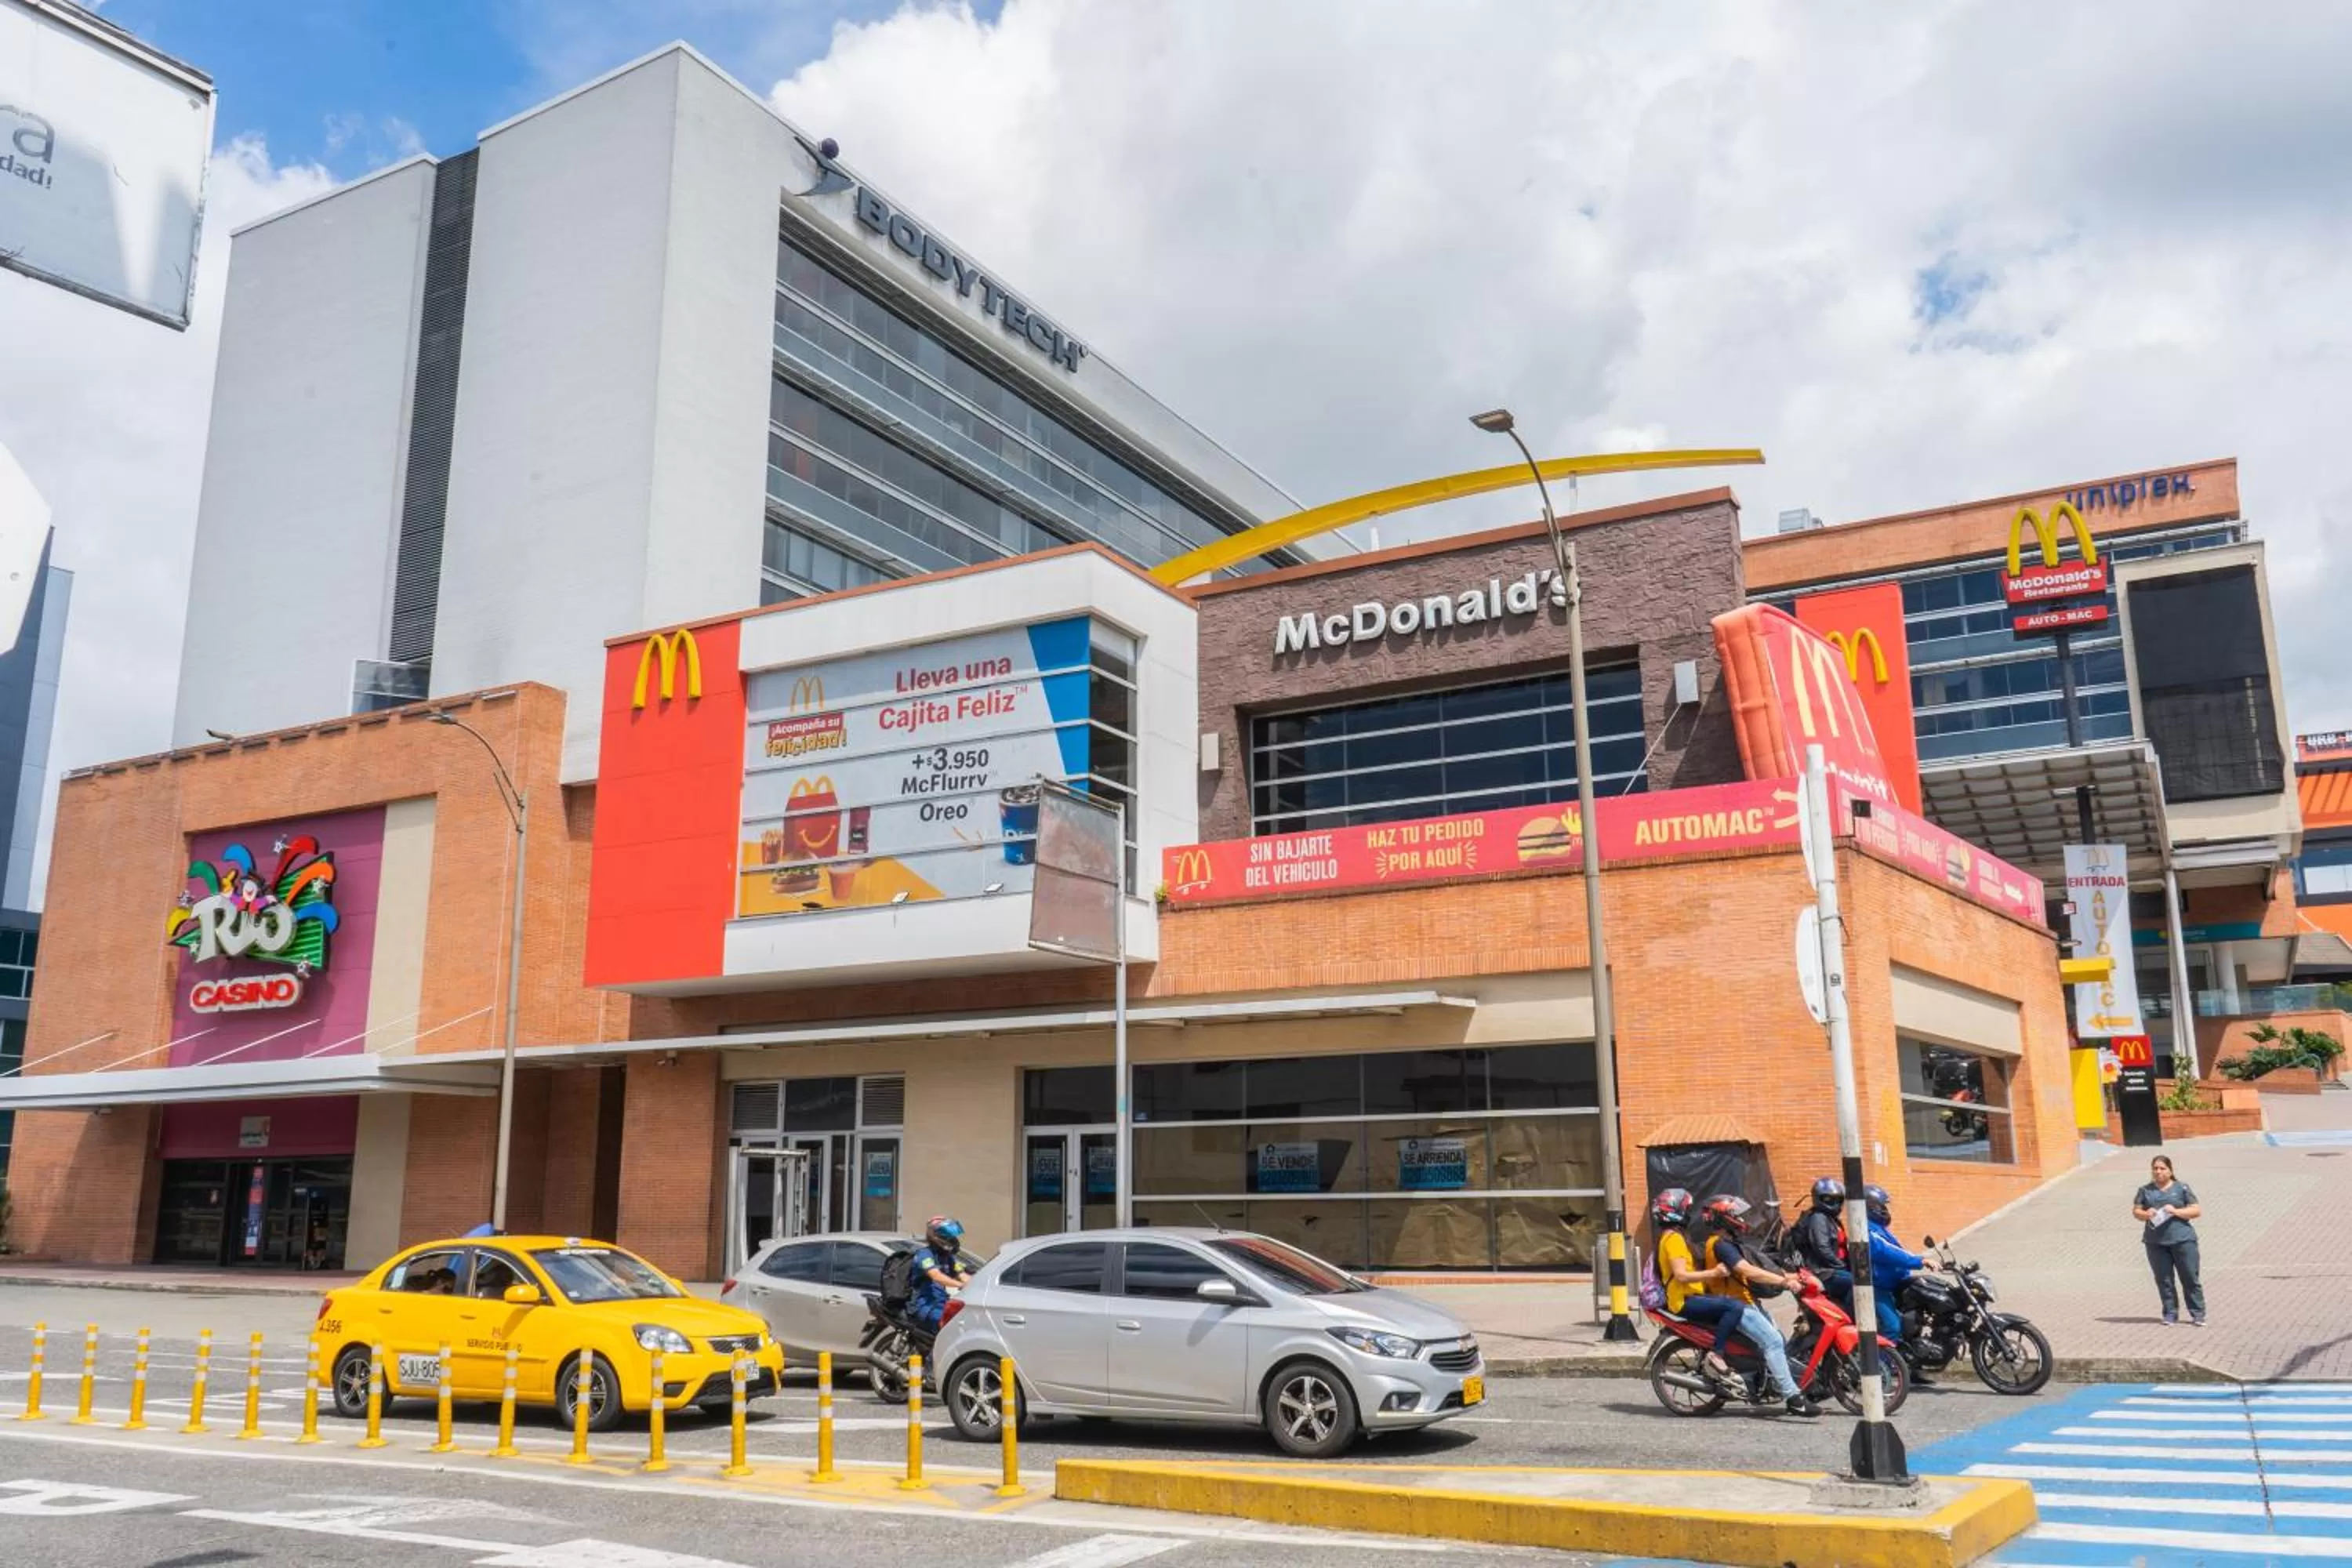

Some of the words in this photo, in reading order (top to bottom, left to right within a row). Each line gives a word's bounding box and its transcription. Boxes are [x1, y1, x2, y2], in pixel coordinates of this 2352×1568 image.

[857, 186, 1079, 372] BODYTECH
[2009, 568, 2102, 590] McDonald's
[2024, 583, 2089, 597] Restaurante
[2027, 614, 2058, 626] AUTO
[2067, 610, 2092, 620] MAC
[895, 666, 958, 694] Lleva
[965, 656, 1012, 681] una
[879, 700, 949, 733] Cajita
[920, 802, 969, 822] Oreo
[1367, 828, 1396, 848] HAZ
[1400, 826, 1420, 844] TU
[1425, 818, 1484, 841] PEDIDO
[1250, 842, 1272, 863] SIN
[1276, 835, 1333, 859] BAJARTE
[1388, 852, 1421, 872] POR
[1425, 843, 1462, 868] AQUÍ
[1245, 866, 1269, 887] DEL
[2067, 876, 2125, 888] ENTRADA
[192, 978, 295, 1007] CASINO
